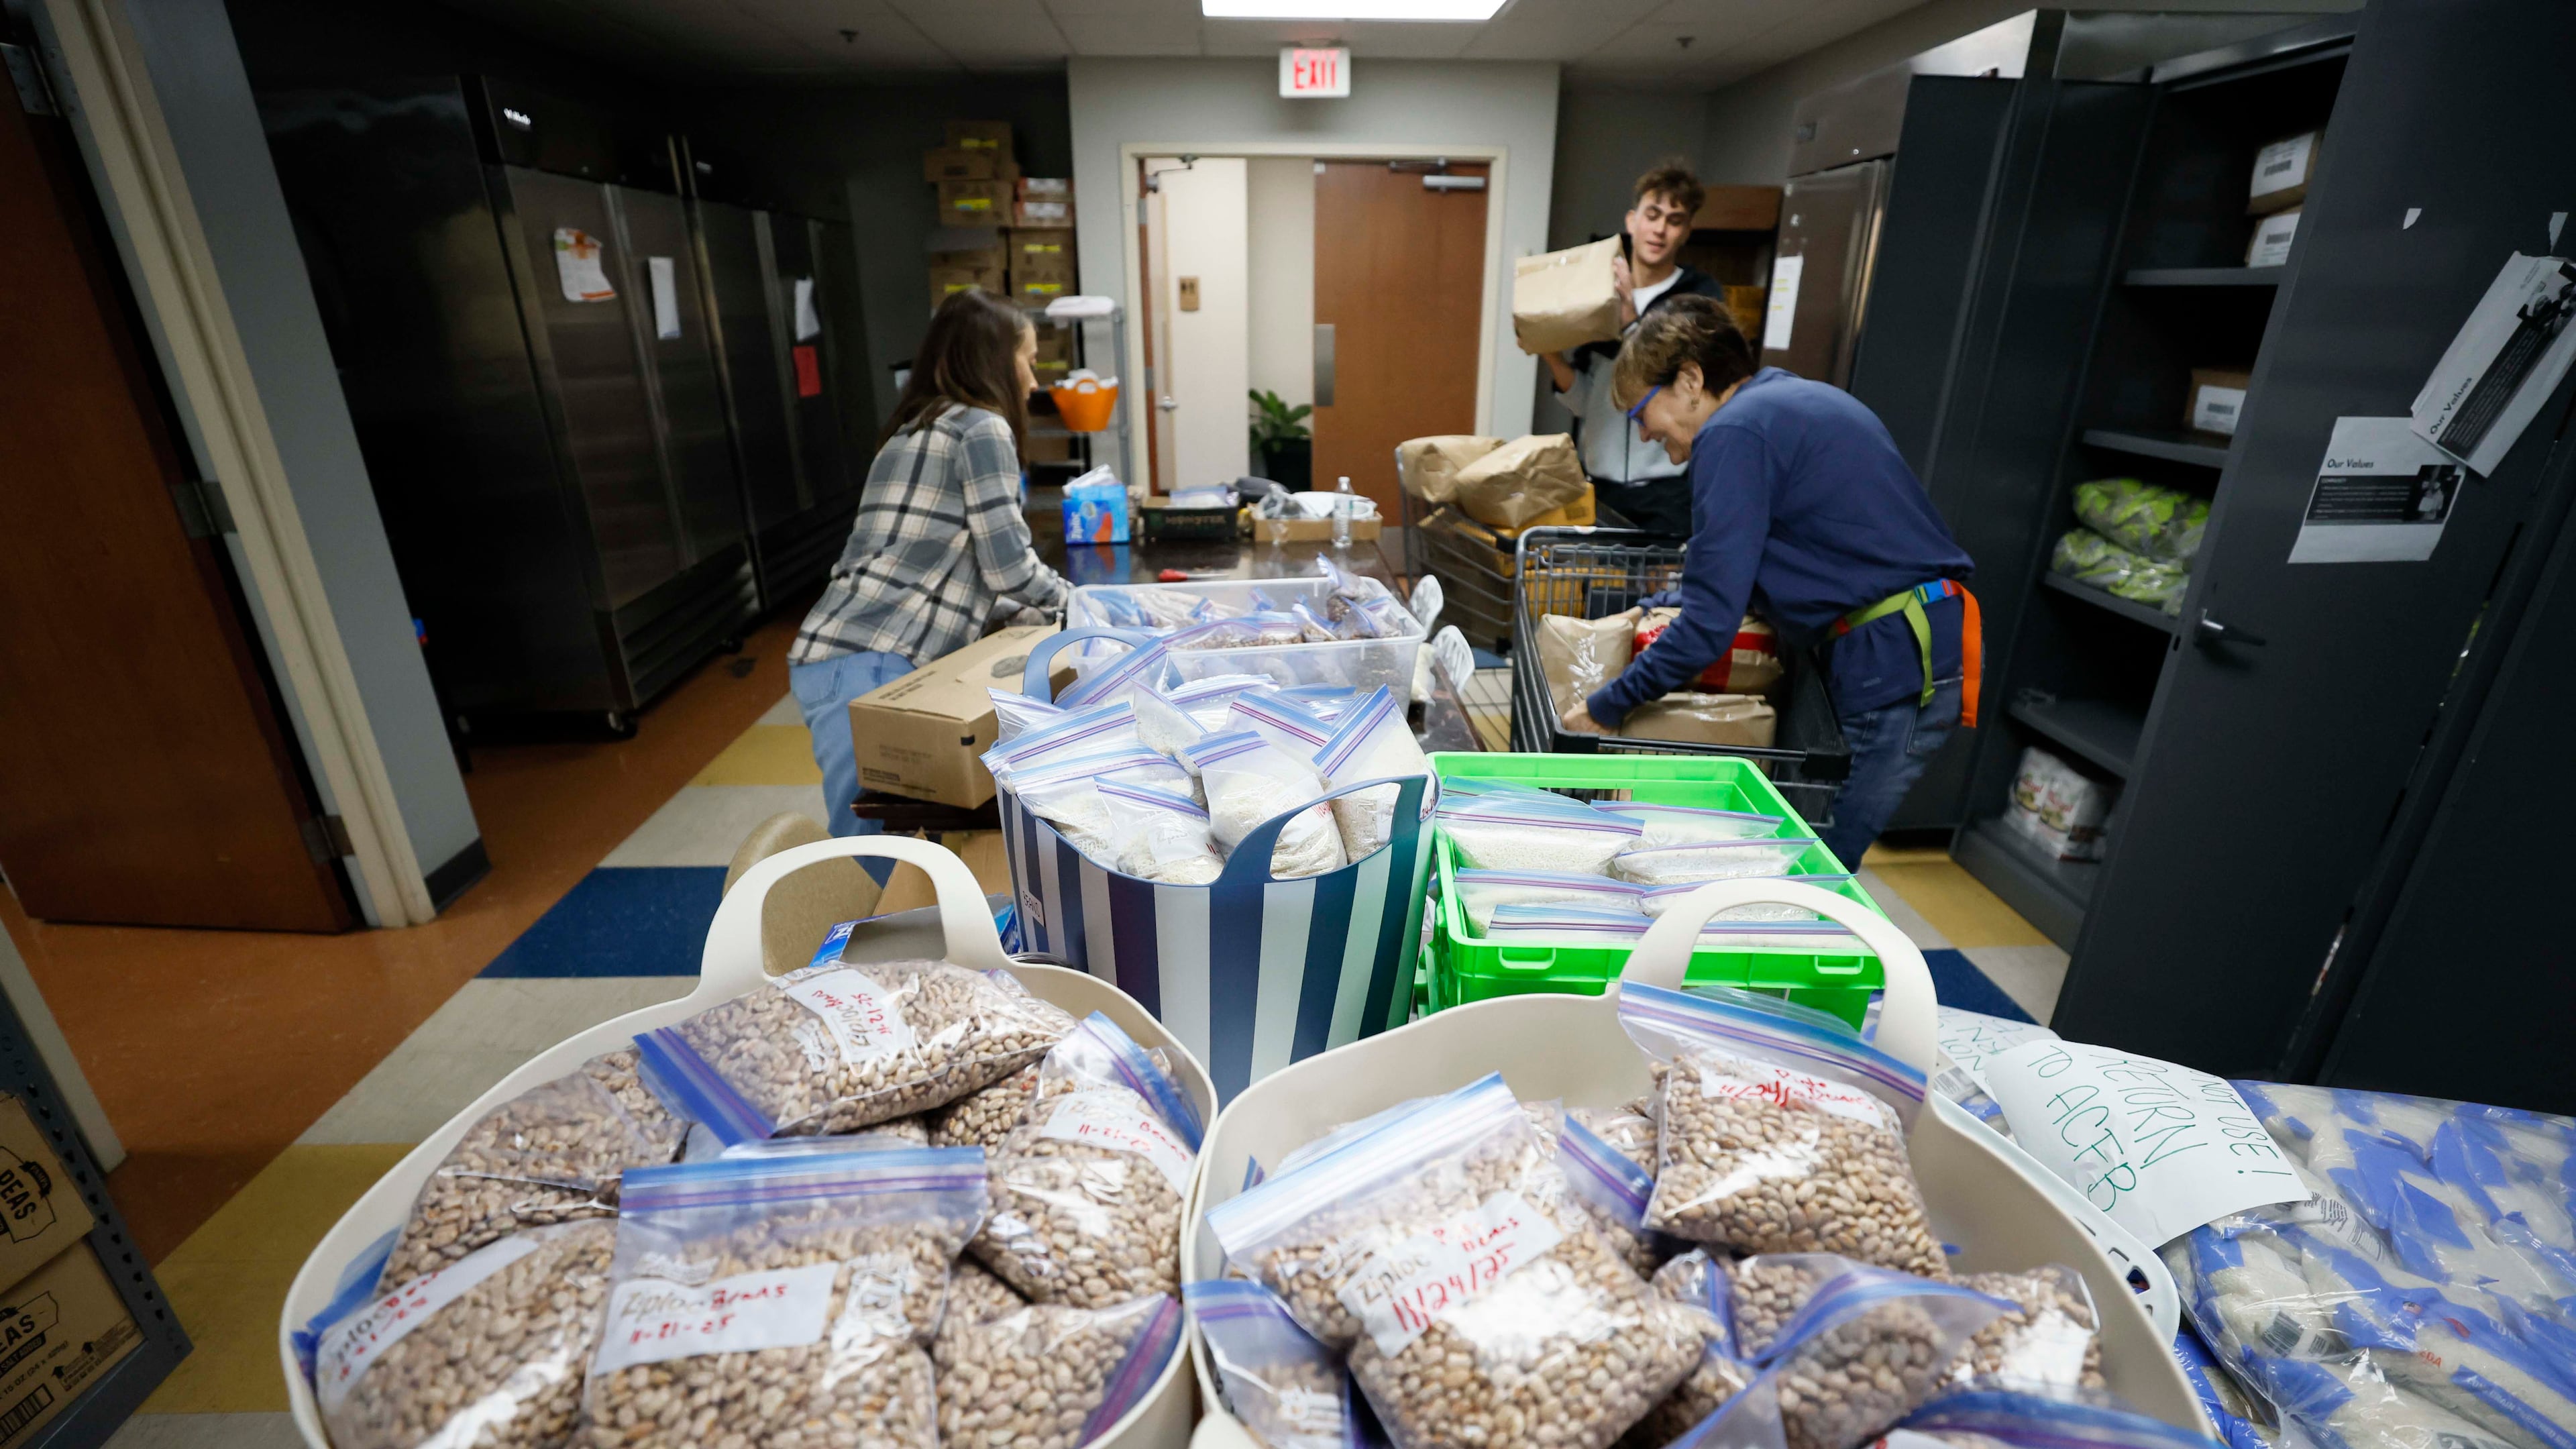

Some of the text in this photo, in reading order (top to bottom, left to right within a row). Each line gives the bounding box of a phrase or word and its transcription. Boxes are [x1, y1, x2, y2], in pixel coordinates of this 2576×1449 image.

[1293, 48, 1340, 89] EXIT
[2430, 415, 2445, 435] Our
[2443, 377, 2472, 411] Values
[2327, 458, 2374, 468] Our Values
[2027, 1044, 2073, 1079] TO
[2088, 1053, 2208, 1170] RETURN
[2190, 1079, 2247, 1111] NOT
[2046, 1085, 2137, 1212] ACFB
